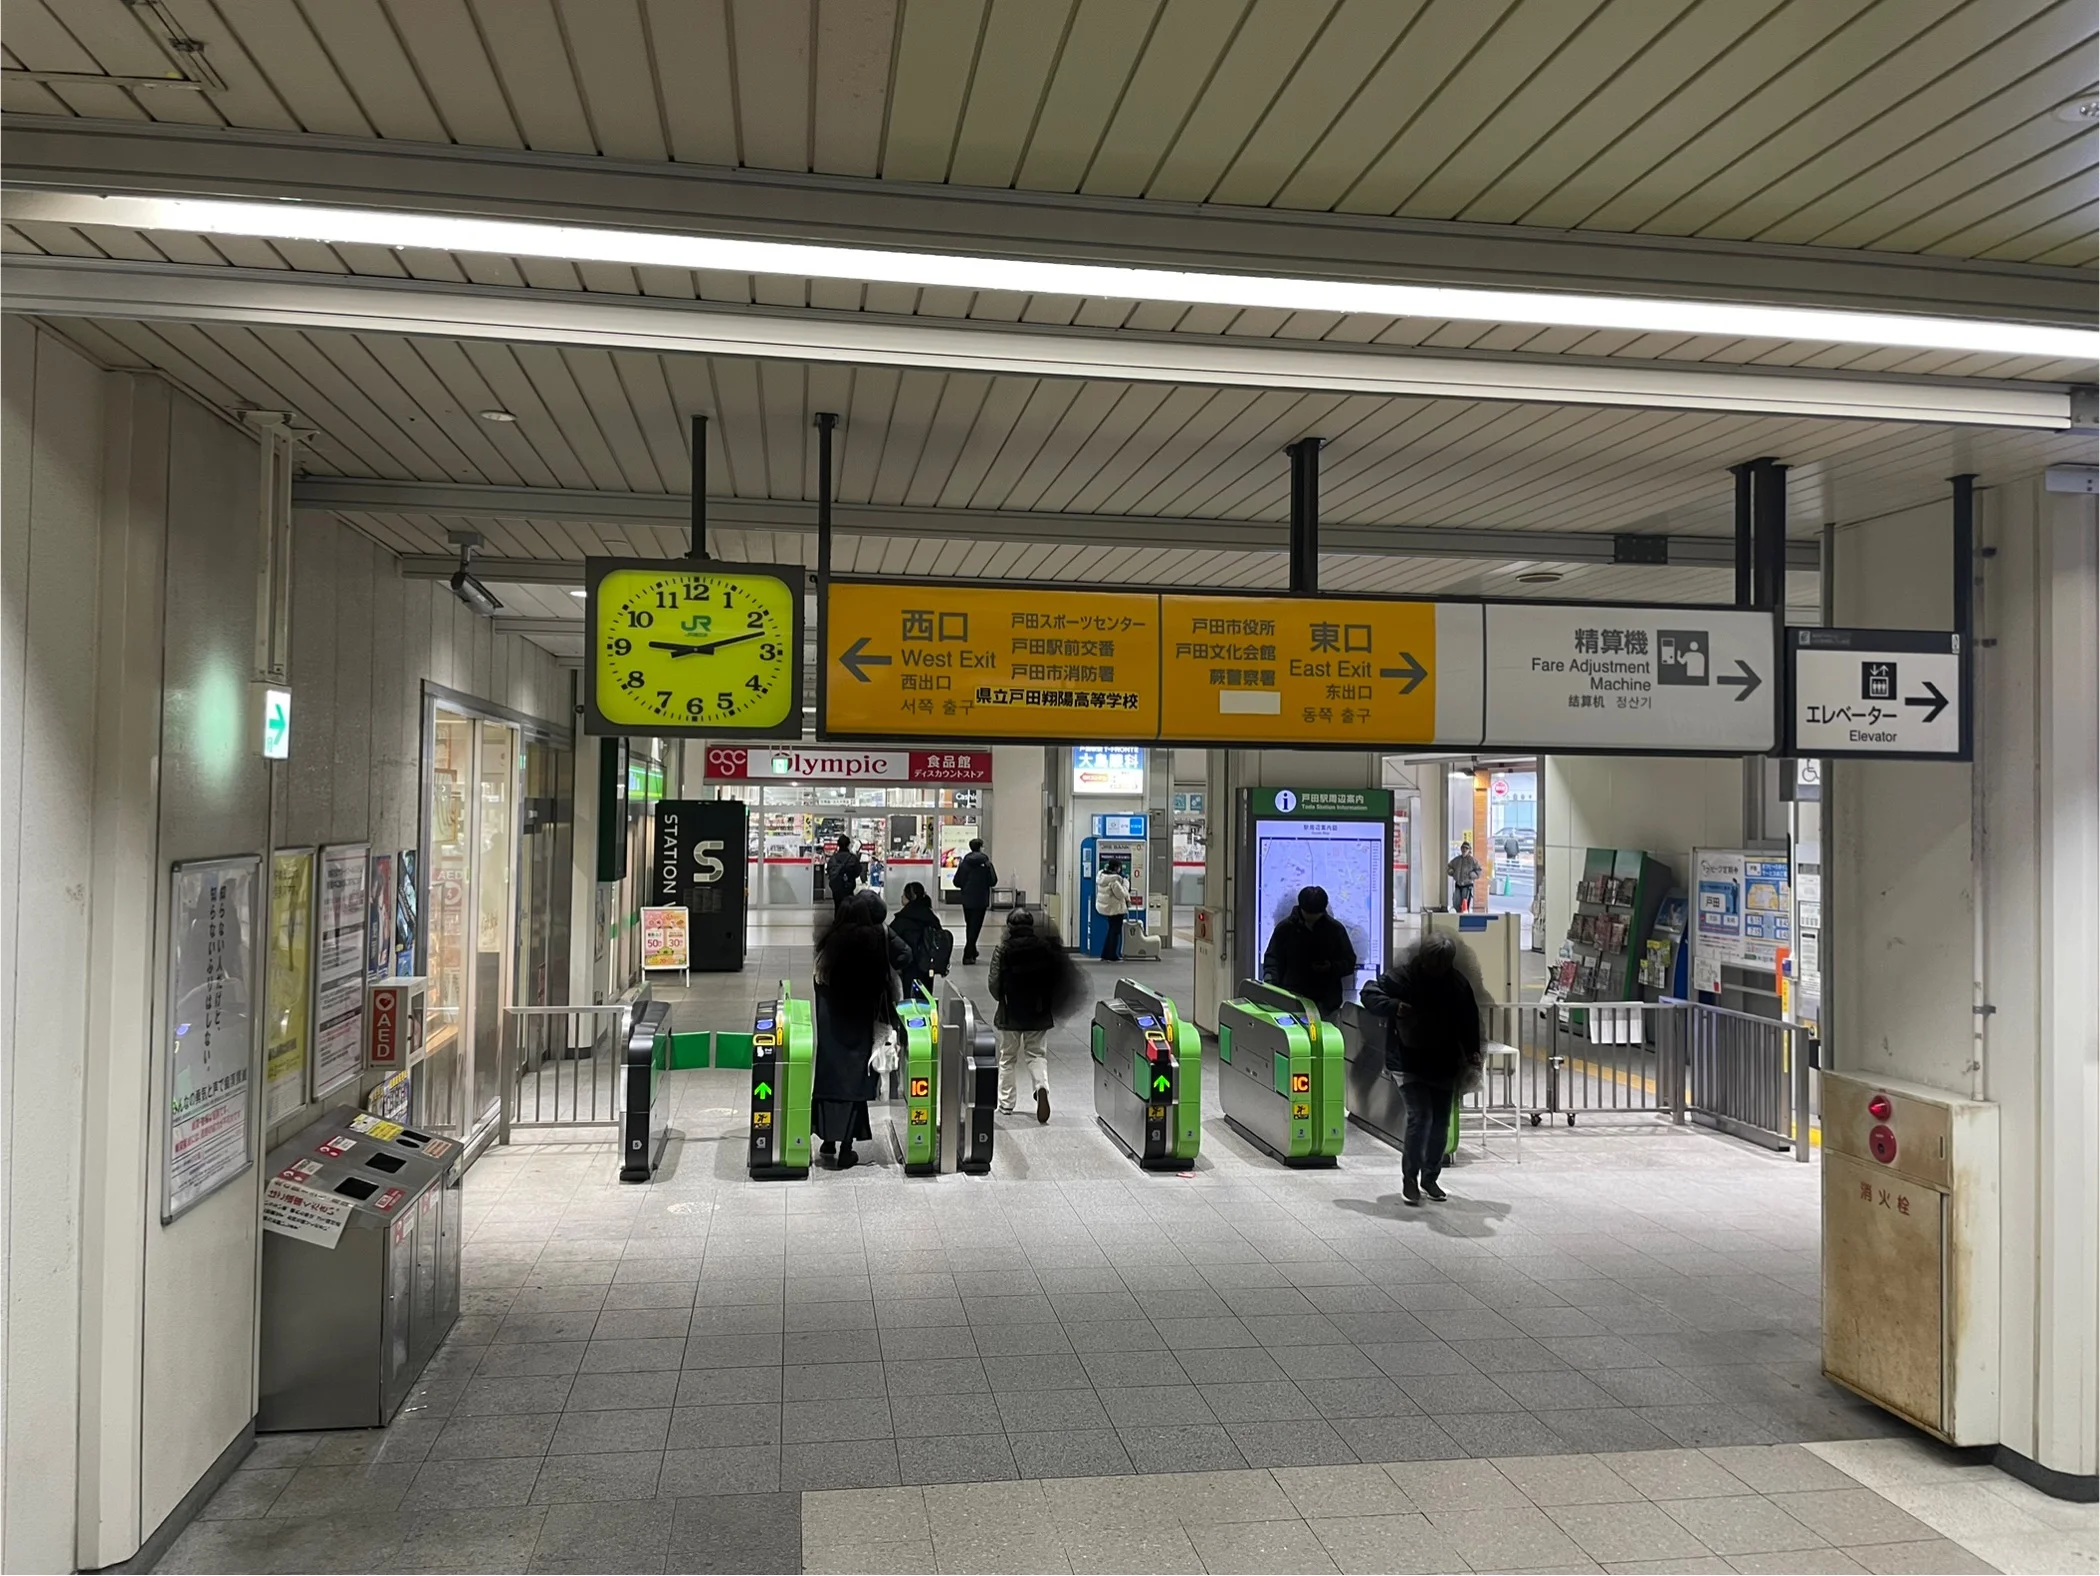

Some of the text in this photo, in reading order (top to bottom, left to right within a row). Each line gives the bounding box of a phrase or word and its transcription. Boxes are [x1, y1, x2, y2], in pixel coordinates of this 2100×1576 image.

[657, 592, 678, 609] 11
[683, 584, 709, 600] 12
[724, 592, 733, 608] 1
[628, 611, 653, 628] 10
[681, 616, 712, 632] JR
[748, 612, 763, 628] 2
[902, 610, 968, 642] 西口
[1011, 612, 1146, 631] 戸田スポーツセンター
[1192, 618, 1275, 636] 戸田市役所
[1310, 622, 1372, 653] 東口
[1574, 629, 1649, 655] 精算機
[614, 639, 631, 655] 9
[760, 644, 775, 660] 3
[1011, 638, 1114, 657] 戸田駅前交番
[1176, 642, 1276, 661] 戸田文化会館
[902, 650, 996, 669] West Exit
[1532, 658, 1650, 675] Fare Adjustment
[1011, 664, 1114, 683] 戸田市消防署
[1209, 668, 1275, 686] 蕨警察署
[1290, 660, 1371, 678] East Exit
[628, 671, 644, 688] 8
[745, 675, 762, 690] 4
[901, 673, 951, 690] 西出口
[1590, 677, 1651, 691] Machine
[657, 692, 672, 708] 7
[717, 693, 733, 709] 5
[976, 688, 1138, 710] 県立戸田翔陽高等学校
[1326, 685, 1372, 700] 东出口
[687, 698, 703, 714] 6
[901, 698, 974, 715] 서쪽 출구
[1568, 695, 1604, 708] 结算机
[1616, 696, 1651, 709] 정산기
[1303, 708, 1371, 724] 동쪽 출구
[1806, 705, 1897, 725] エレベーター
[1850, 730, 1897, 742] Elevator
[927, 755, 970, 768] 食品館
[914, 770, 983, 778] ディスカウントストア
[1302, 793, 1364, 804] 戸田駅周辺案内
[663, 814, 678, 893] STATION
[376, 1014, 391, 1057] AED
[912, 1081, 928, 1095] IC
[1293, 1076, 1308, 1091] IC
[1861, 1181, 1910, 1216] 消火栓
